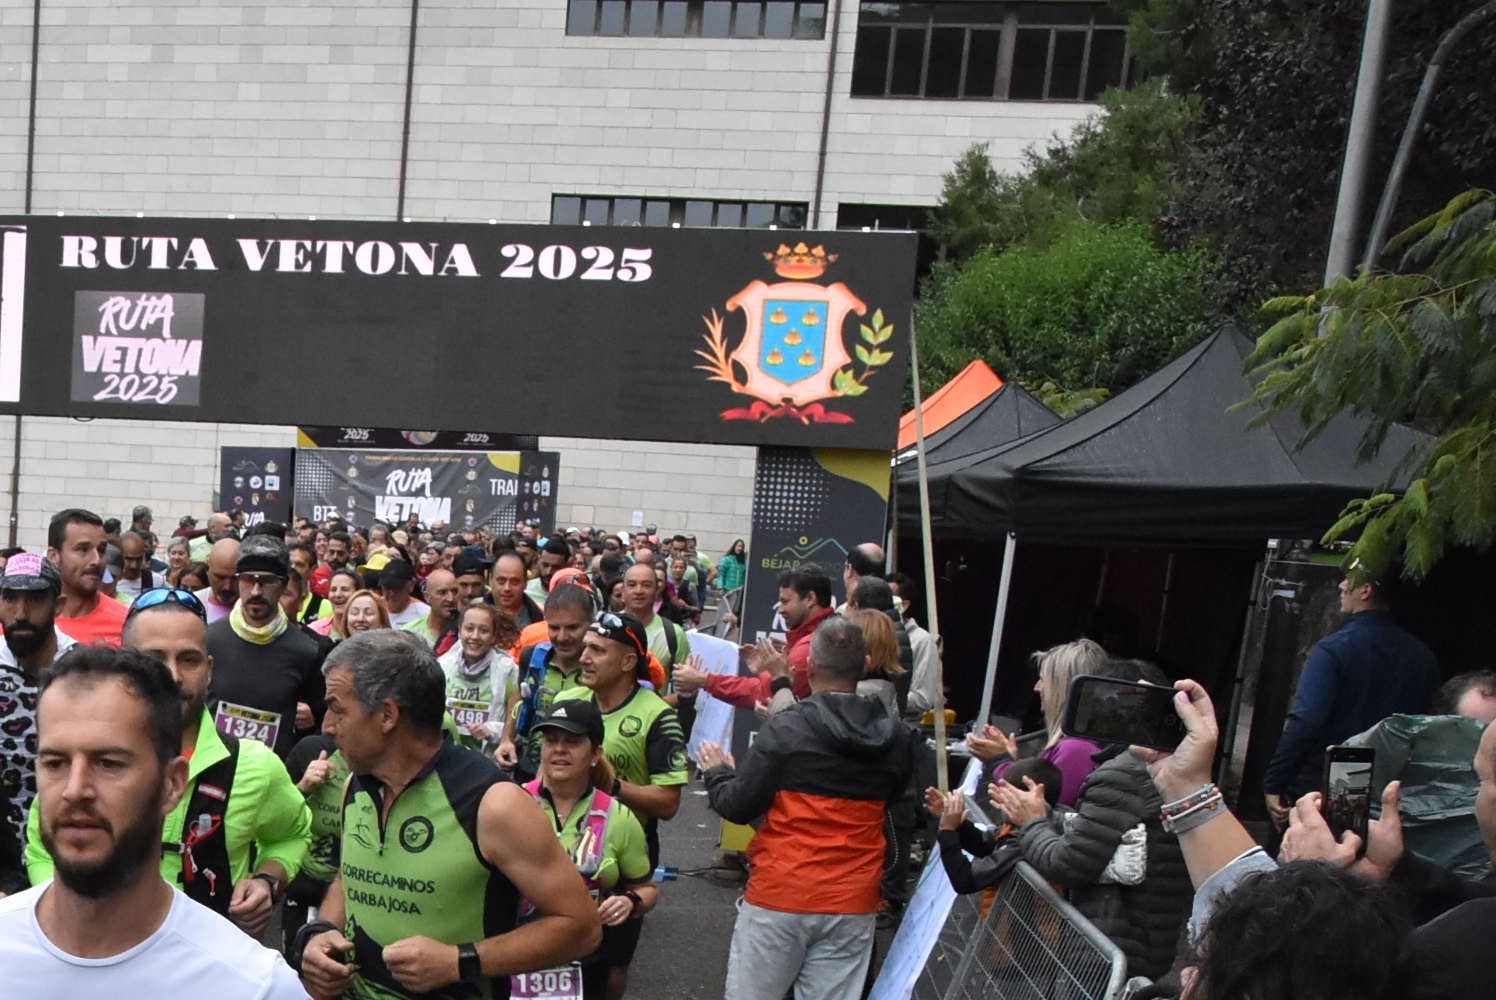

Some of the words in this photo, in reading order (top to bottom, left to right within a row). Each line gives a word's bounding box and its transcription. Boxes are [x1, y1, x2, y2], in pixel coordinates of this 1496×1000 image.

[59, 235, 218, 271] RUTA
[236, 238, 481, 276] VETONA
[500, 243, 653, 283] 2025
[98, 293, 175, 339] RUTA
[81, 334, 203, 377] VETONA
[92, 373, 179, 405] 2025
[385, 467, 433, 497] RUTA
[243, 511, 265, 528] UTA
[313, 504, 338, 522] BTT
[375, 495, 452, 525] VETONA
[224, 716, 270, 741] 1324
[342, 861, 436, 894] CORRECAMINOS
[347, 887, 423, 916] CARBAJOSA
[516, 971, 572, 993] 1306
